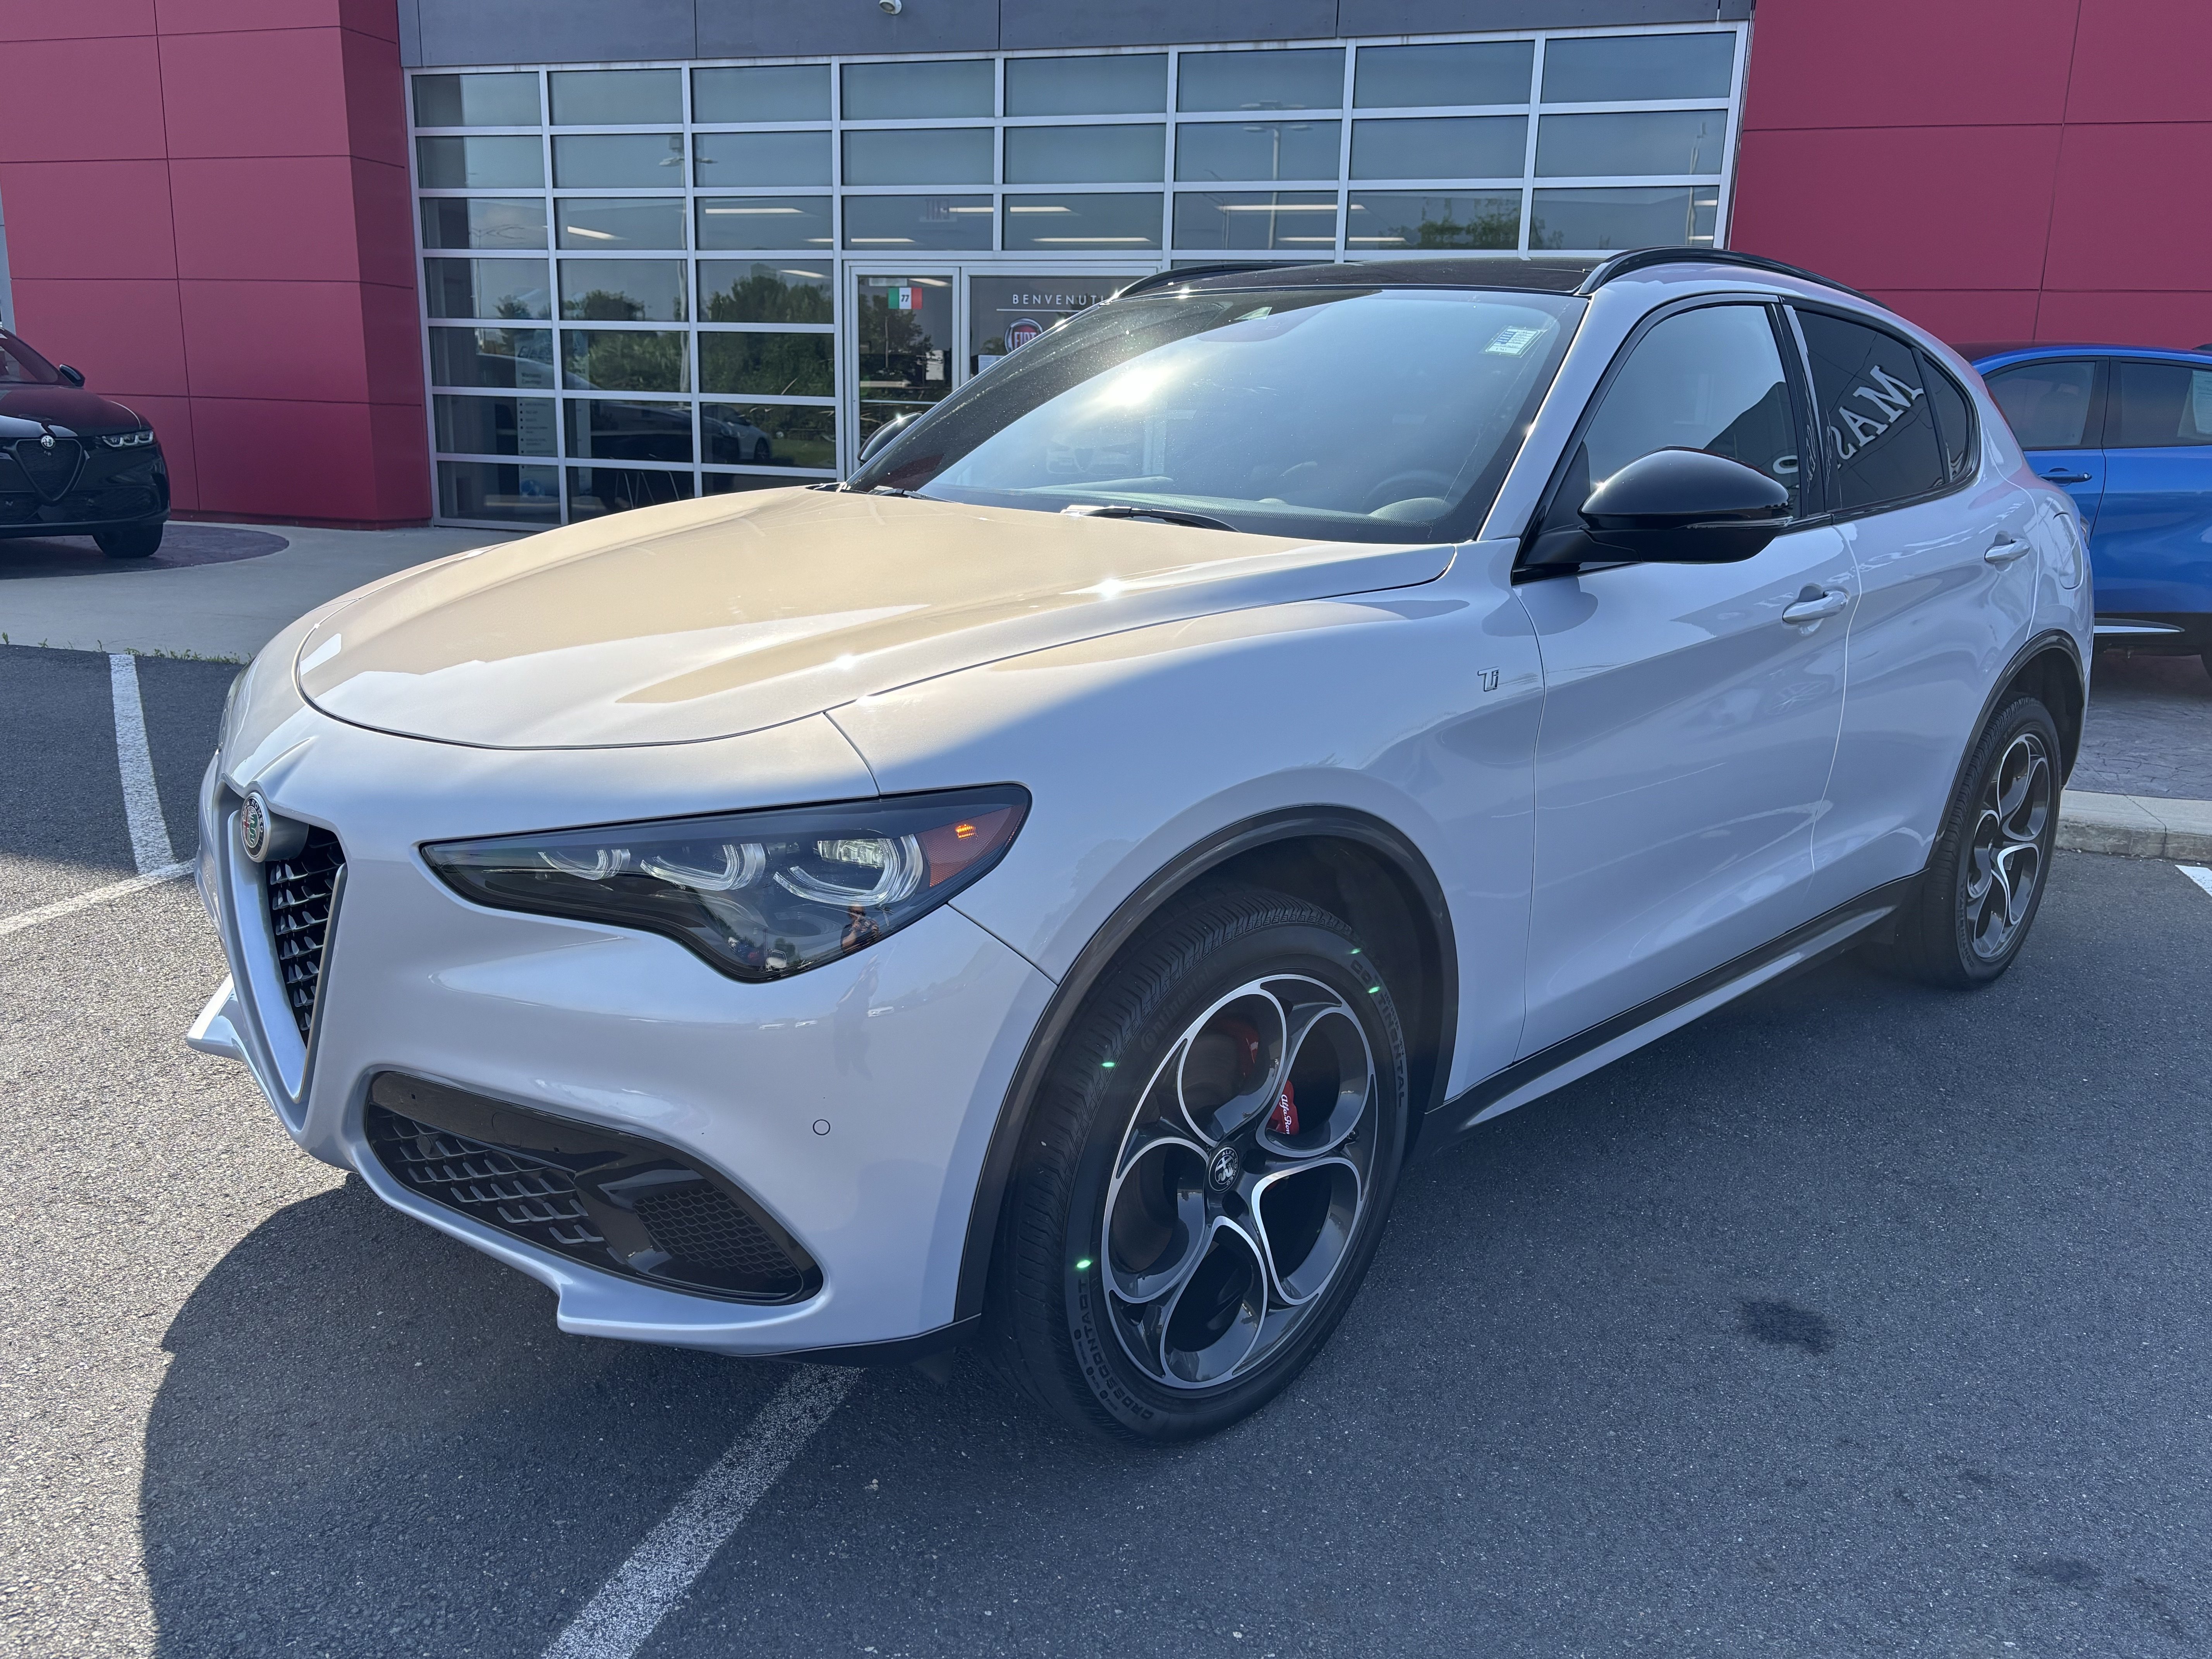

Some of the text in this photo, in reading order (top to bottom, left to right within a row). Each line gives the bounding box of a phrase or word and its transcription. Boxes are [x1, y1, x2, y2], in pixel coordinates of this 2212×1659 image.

[1477, 666, 1499, 692] Ti
[251, 800, 263, 833] ROMEO
[1078, 1279, 1155, 1420] CROSSCONTACT
